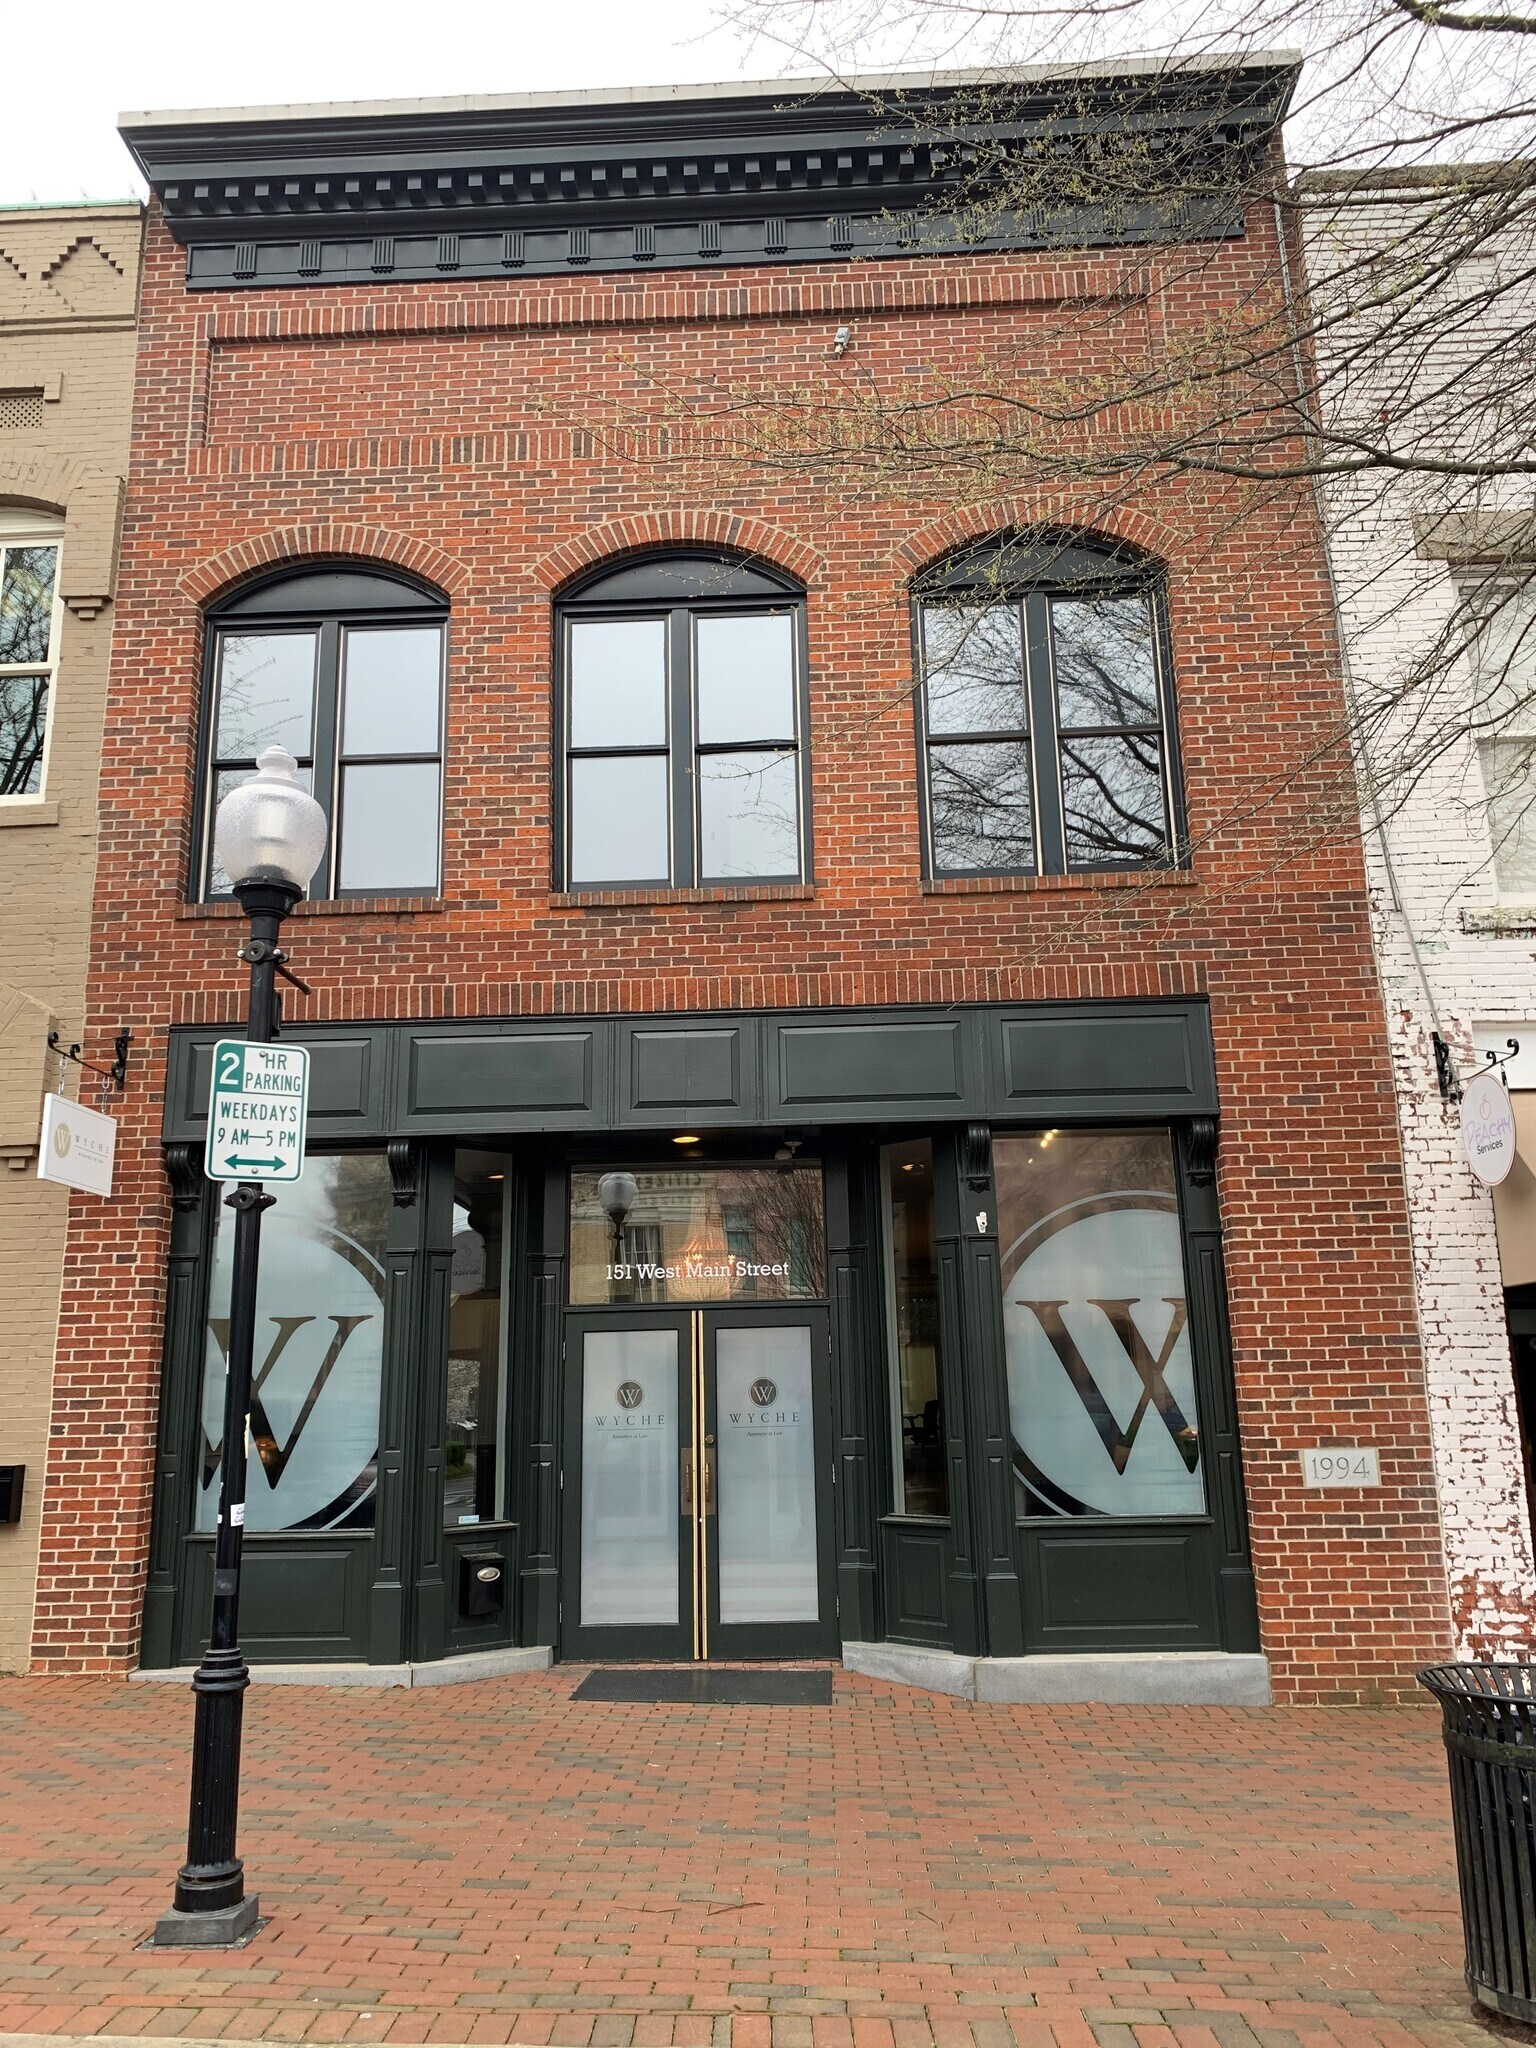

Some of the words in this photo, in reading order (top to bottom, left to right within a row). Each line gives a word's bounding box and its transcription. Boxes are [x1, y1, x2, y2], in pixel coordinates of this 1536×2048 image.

[219, 1052, 240, 1085] 2
[265, 1053, 287, 1070] HR
[245, 1072, 301, 1092] PARKING
[220, 1101, 297, 1122] WEEKDAYS
[56, 1128, 70, 1152] W
[217, 1127, 226, 1144] 9
[278, 1131, 296, 1148] PM
[1464, 1114, 1512, 1151] PEACHY
[75, 1134, 110, 1154] WYCHE
[1476, 1139, 1504, 1155] Services
[606, 1264, 632, 1280] 151
[636, 1263, 681, 1280] West
[685, 1262, 731, 1279] Main
[736, 1261, 790, 1278] Street
[620, 1389, 640, 1405] W
[752, 1386, 774, 1403] W
[595, 1414, 666, 1426] WYCHE
[729, 1411, 800, 1424] WYCHE
[1312, 1456, 1370, 1480] 1994
